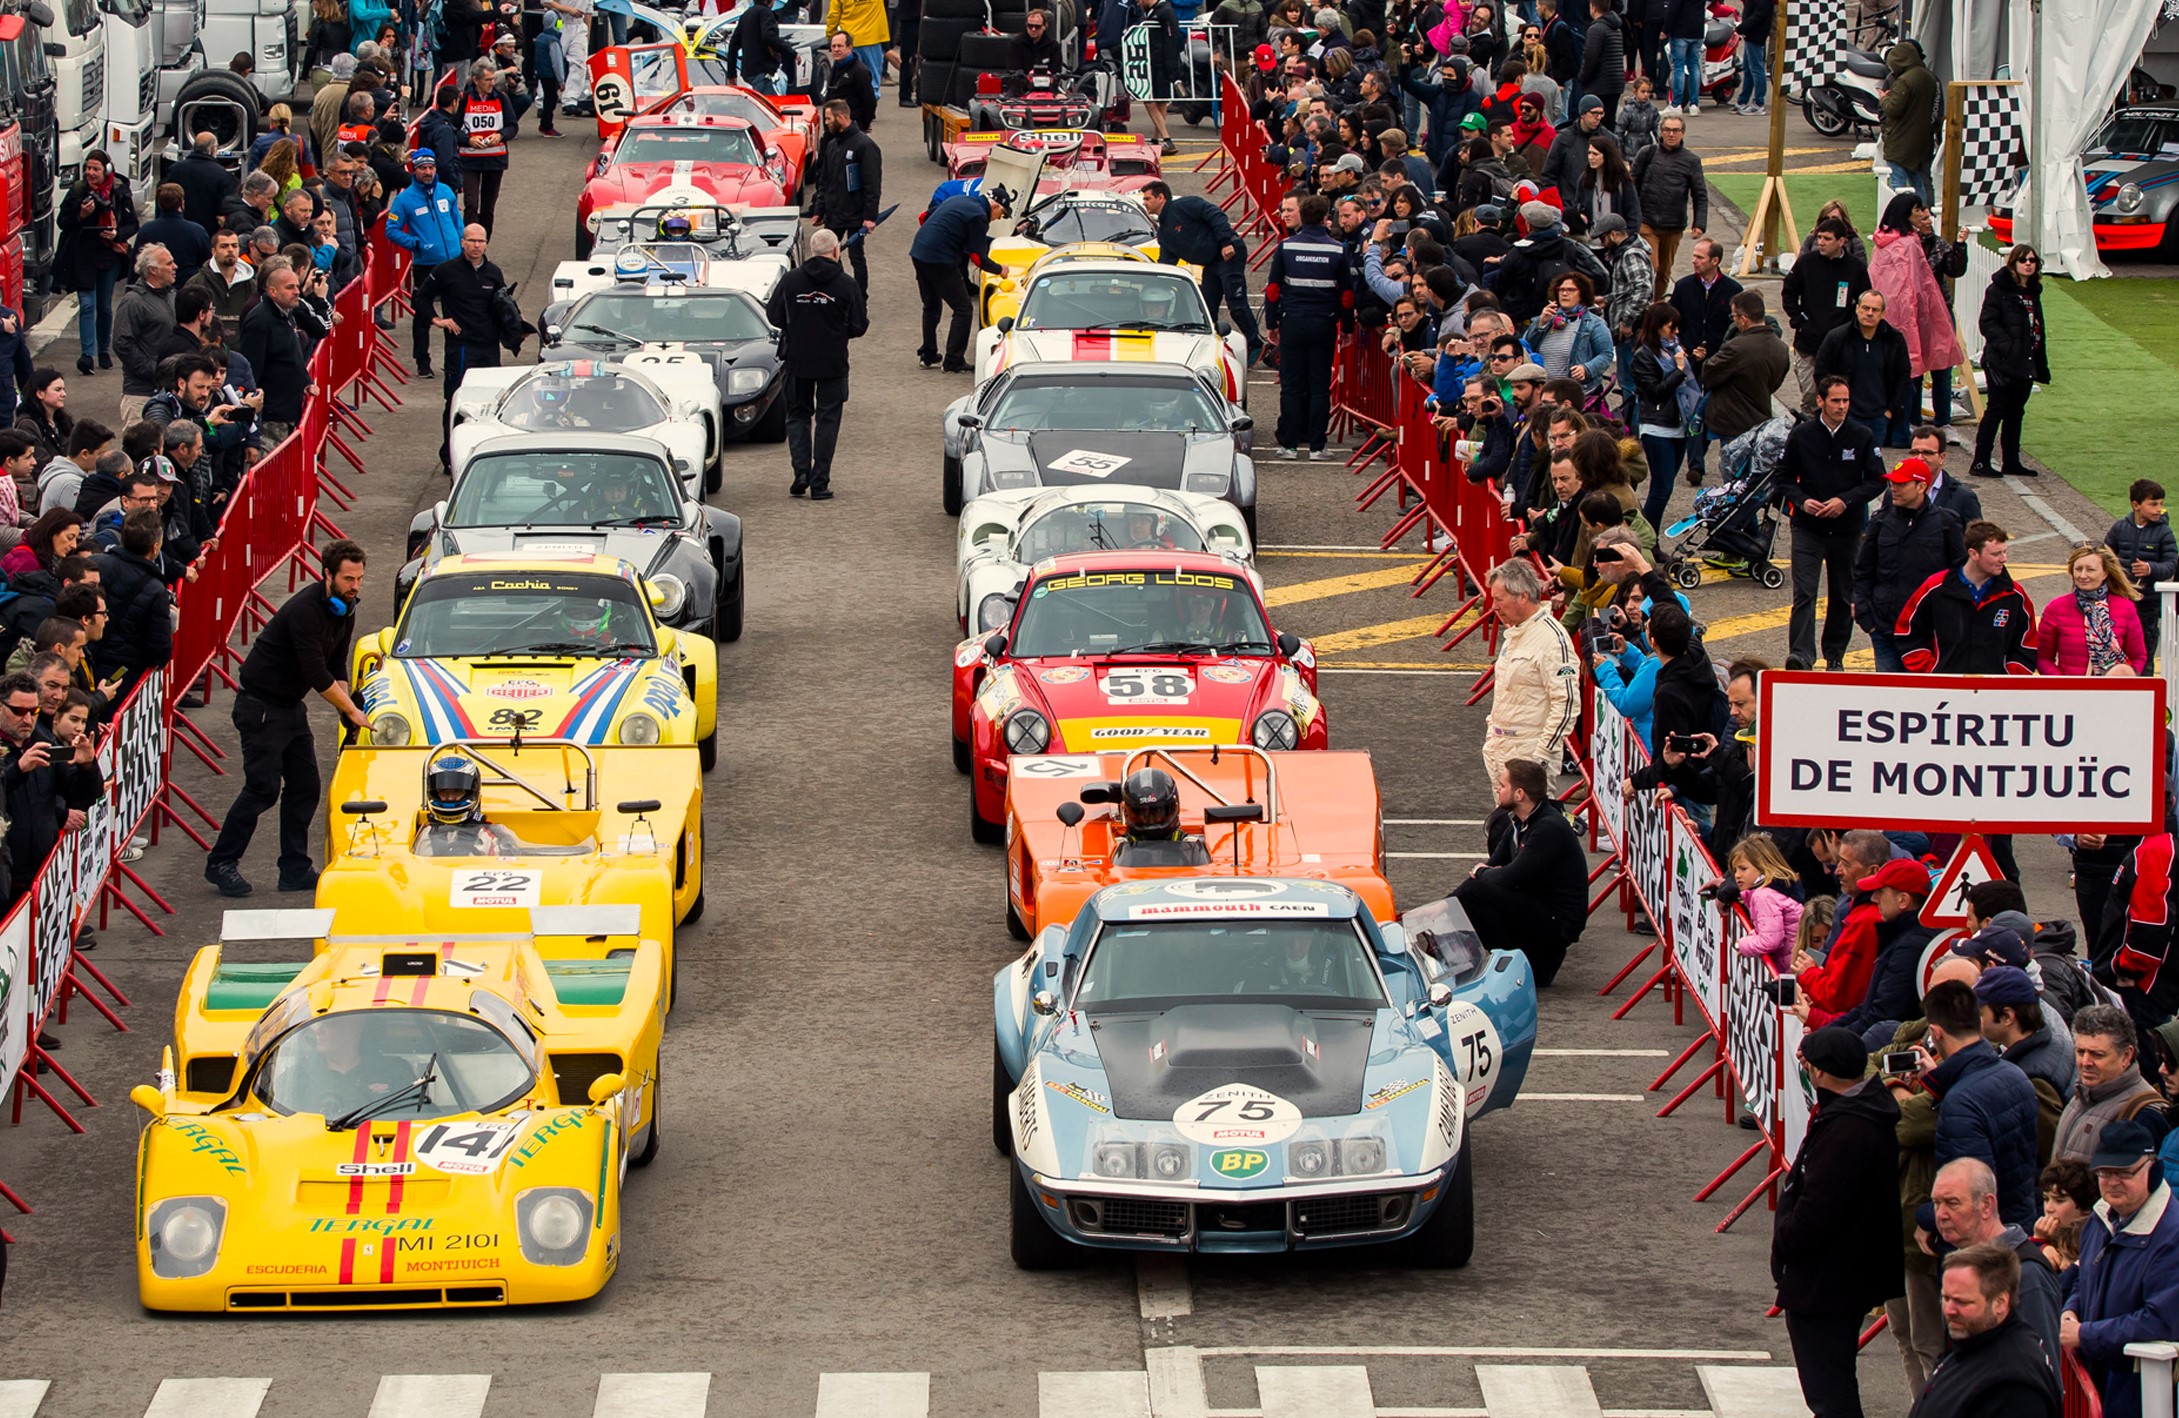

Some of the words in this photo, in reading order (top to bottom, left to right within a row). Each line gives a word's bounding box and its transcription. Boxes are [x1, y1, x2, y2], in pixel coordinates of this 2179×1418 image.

[469, 105, 496, 113] MEDIA
[472, 116, 495, 129] 050
[338, 130, 358, 140] MEDIA
[672, 197, 690, 206] 3
[1295, 255, 1329, 263] ORGANISATION
[1069, 457, 1118, 470] 55
[1047, 574, 1146, 592] GEORG
[1155, 573, 1234, 590] LOOS
[1108, 674, 1188, 697] 58
[489, 708, 543, 726] 82
[1837, 701, 2074, 747] ESPÍRITU
[1094, 728, 1144, 737] GOOD
[1162, 727, 1207, 737] YEAR
[1790, 758, 1853, 793] DE
[1871, 755, 2132, 799] MONTJUÏC
[462, 875, 531, 892] 22
[473, 897, 516, 905] MOTUL
[1140, 903, 1262, 915] mammouth
[1450, 1008, 1478, 1025] ZENITH
[1460, 1029, 1493, 1083] 75
[1203, 1090, 1271, 1100] ZENITH
[1193, 1100, 1276, 1122] 75
[507, 1107, 590, 1168] TERGA
[1214, 1129, 1264, 1138] MOTUL
[166, 1115, 247, 1178] ERGAL
[338, 1163, 412, 1174] Shell
[438, 1161, 488, 1173] MOTUL
[1221, 1152, 1264, 1171] BP
[306, 1217, 438, 1237] TERGAL
[444, 1233, 499, 1250] 2101
[245, 1264, 328, 1275] ESCUDERIA
[405, 1257, 501, 1272] MONTJUICH
